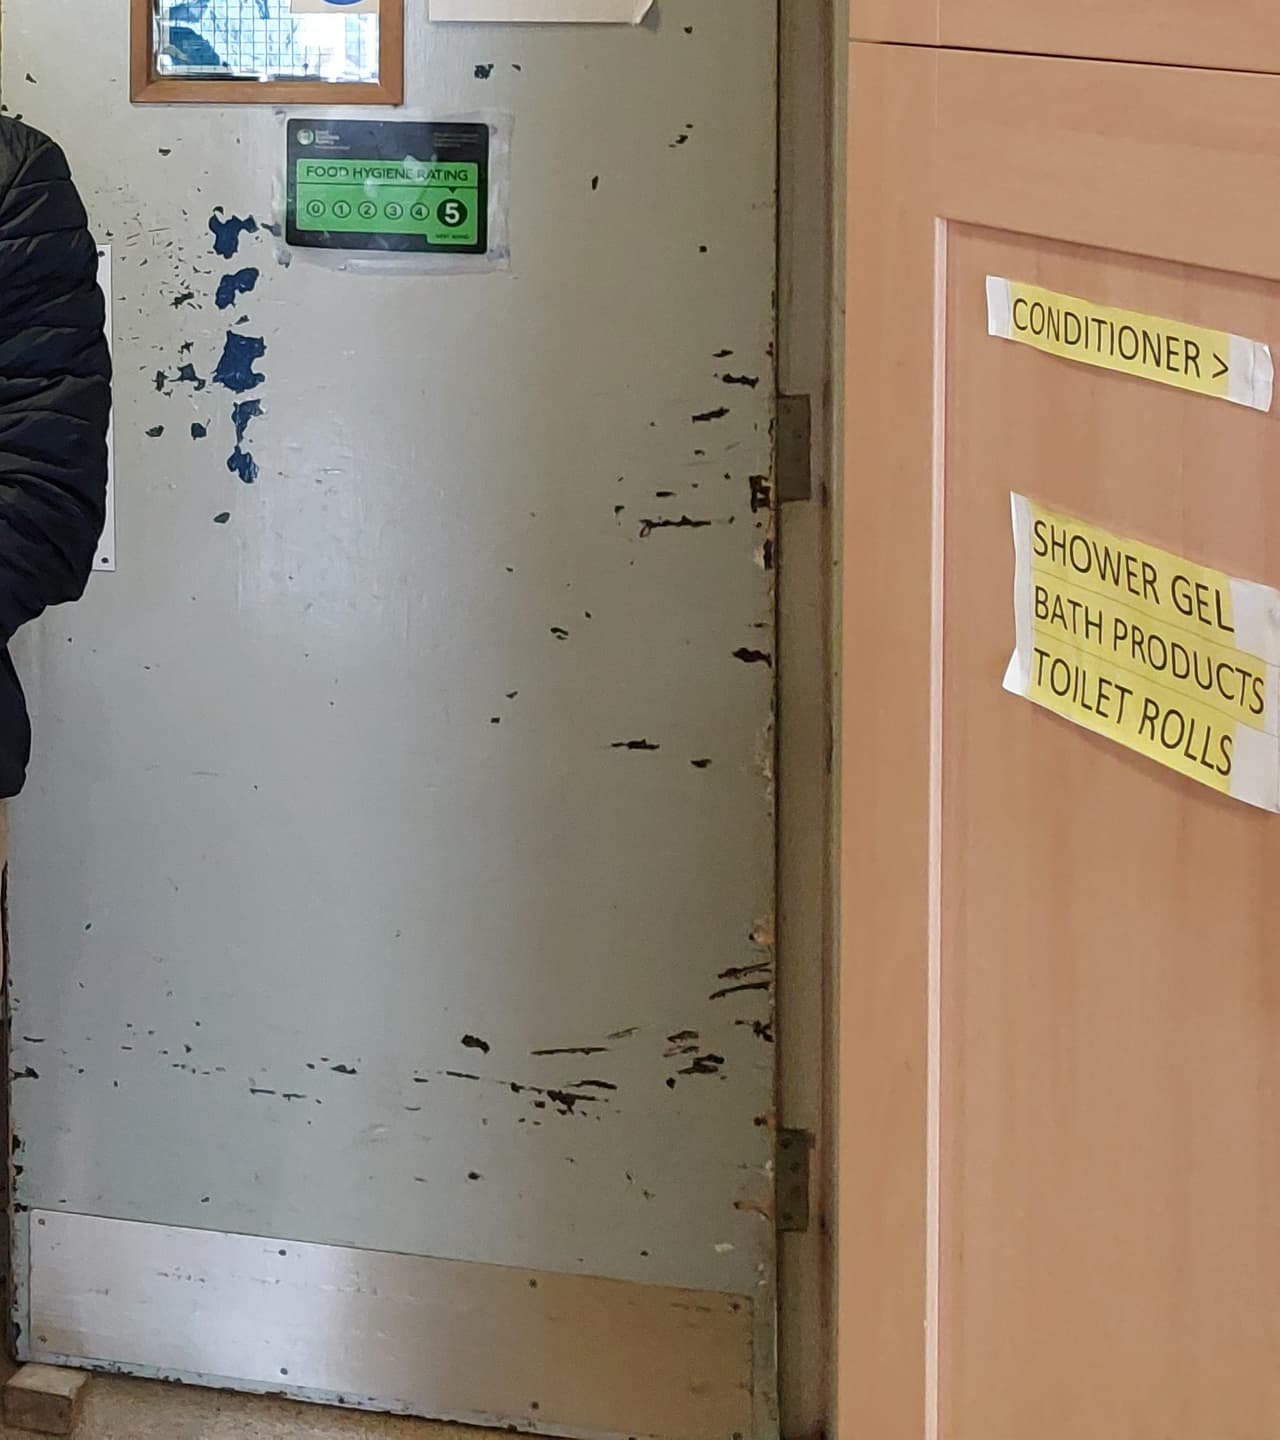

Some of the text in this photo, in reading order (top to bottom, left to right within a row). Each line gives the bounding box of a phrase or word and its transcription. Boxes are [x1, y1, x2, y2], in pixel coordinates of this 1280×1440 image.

[306, 166, 468, 181] FOOD HYGIENE RATING
[312, 203, 460, 224] 0 1 2 3 4 5
[1013, 297, 1201, 378] CONDITIONER
[1033, 519, 1235, 634] SHOWER GEL
[1035, 584, 1265, 716] BATH PRODUCTS
[1034, 647, 1233, 778] TOILET ROLLS
